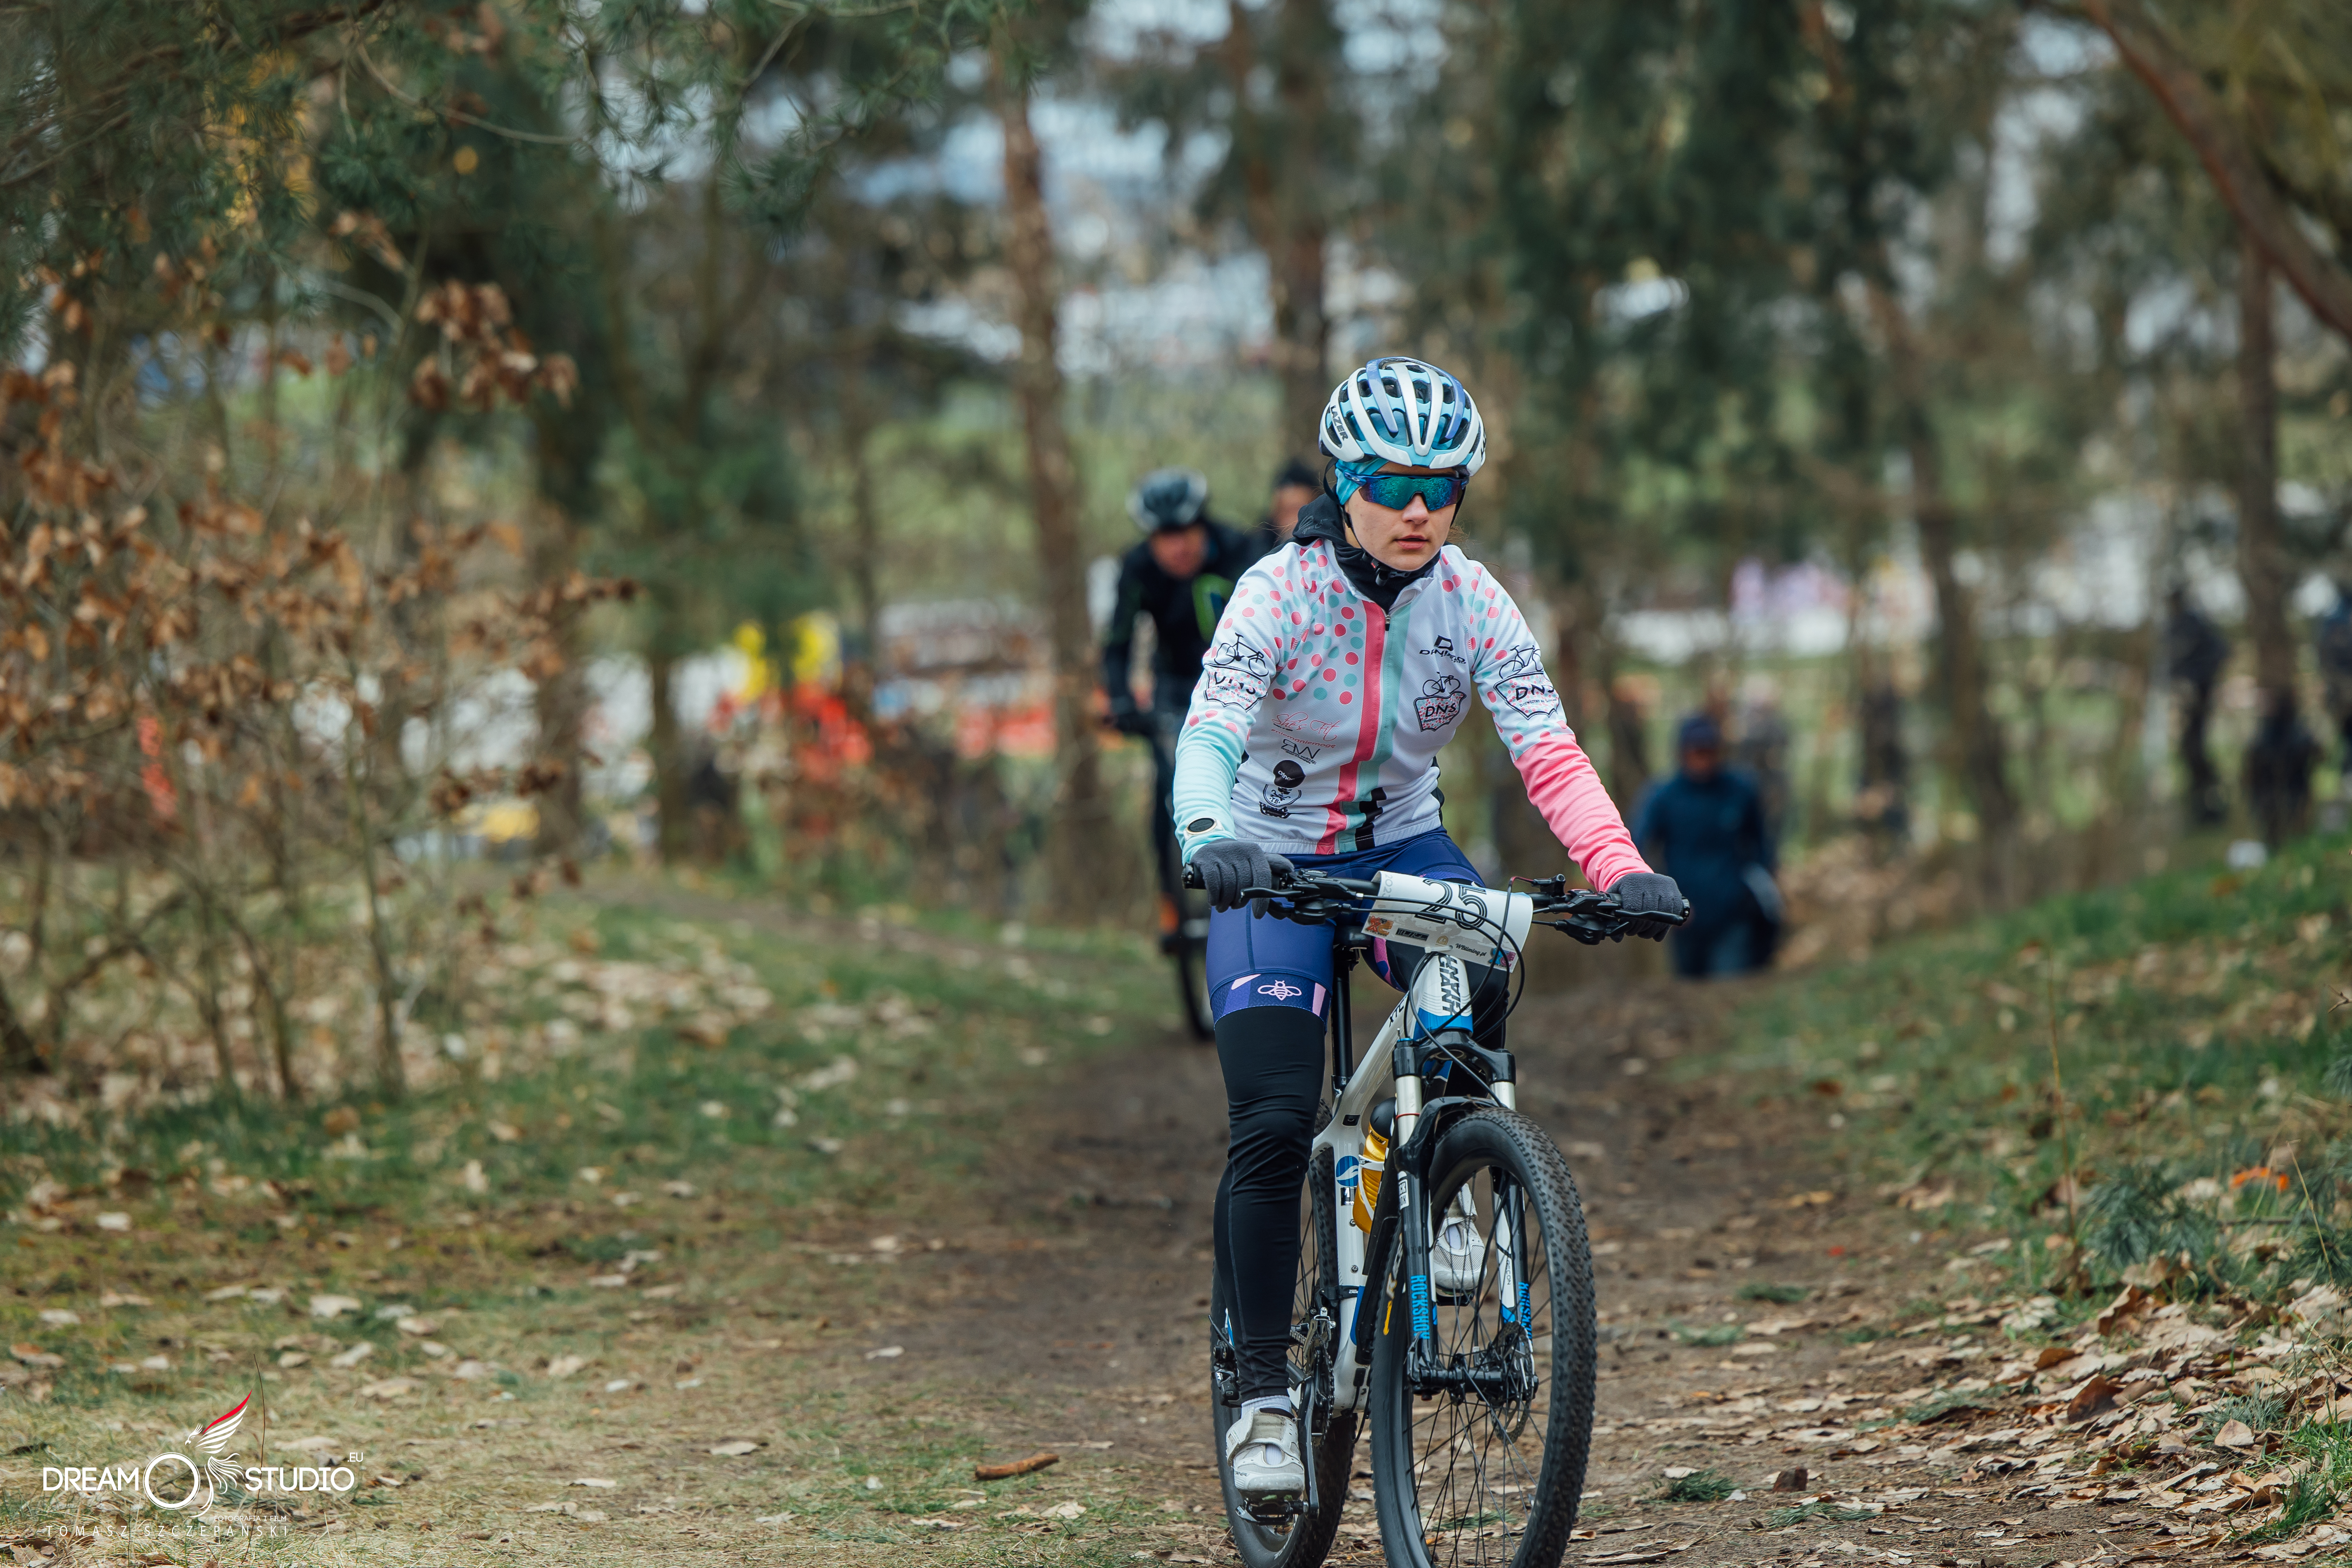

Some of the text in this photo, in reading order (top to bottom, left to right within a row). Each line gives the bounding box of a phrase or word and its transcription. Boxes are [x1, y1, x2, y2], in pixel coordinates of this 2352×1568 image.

[1331, 405, 1348, 441] LAZER
[1425, 702, 1456, 717] DNS
[1414, 879, 1487, 931] 25
[1439, 955, 1453, 1014] GIANT
